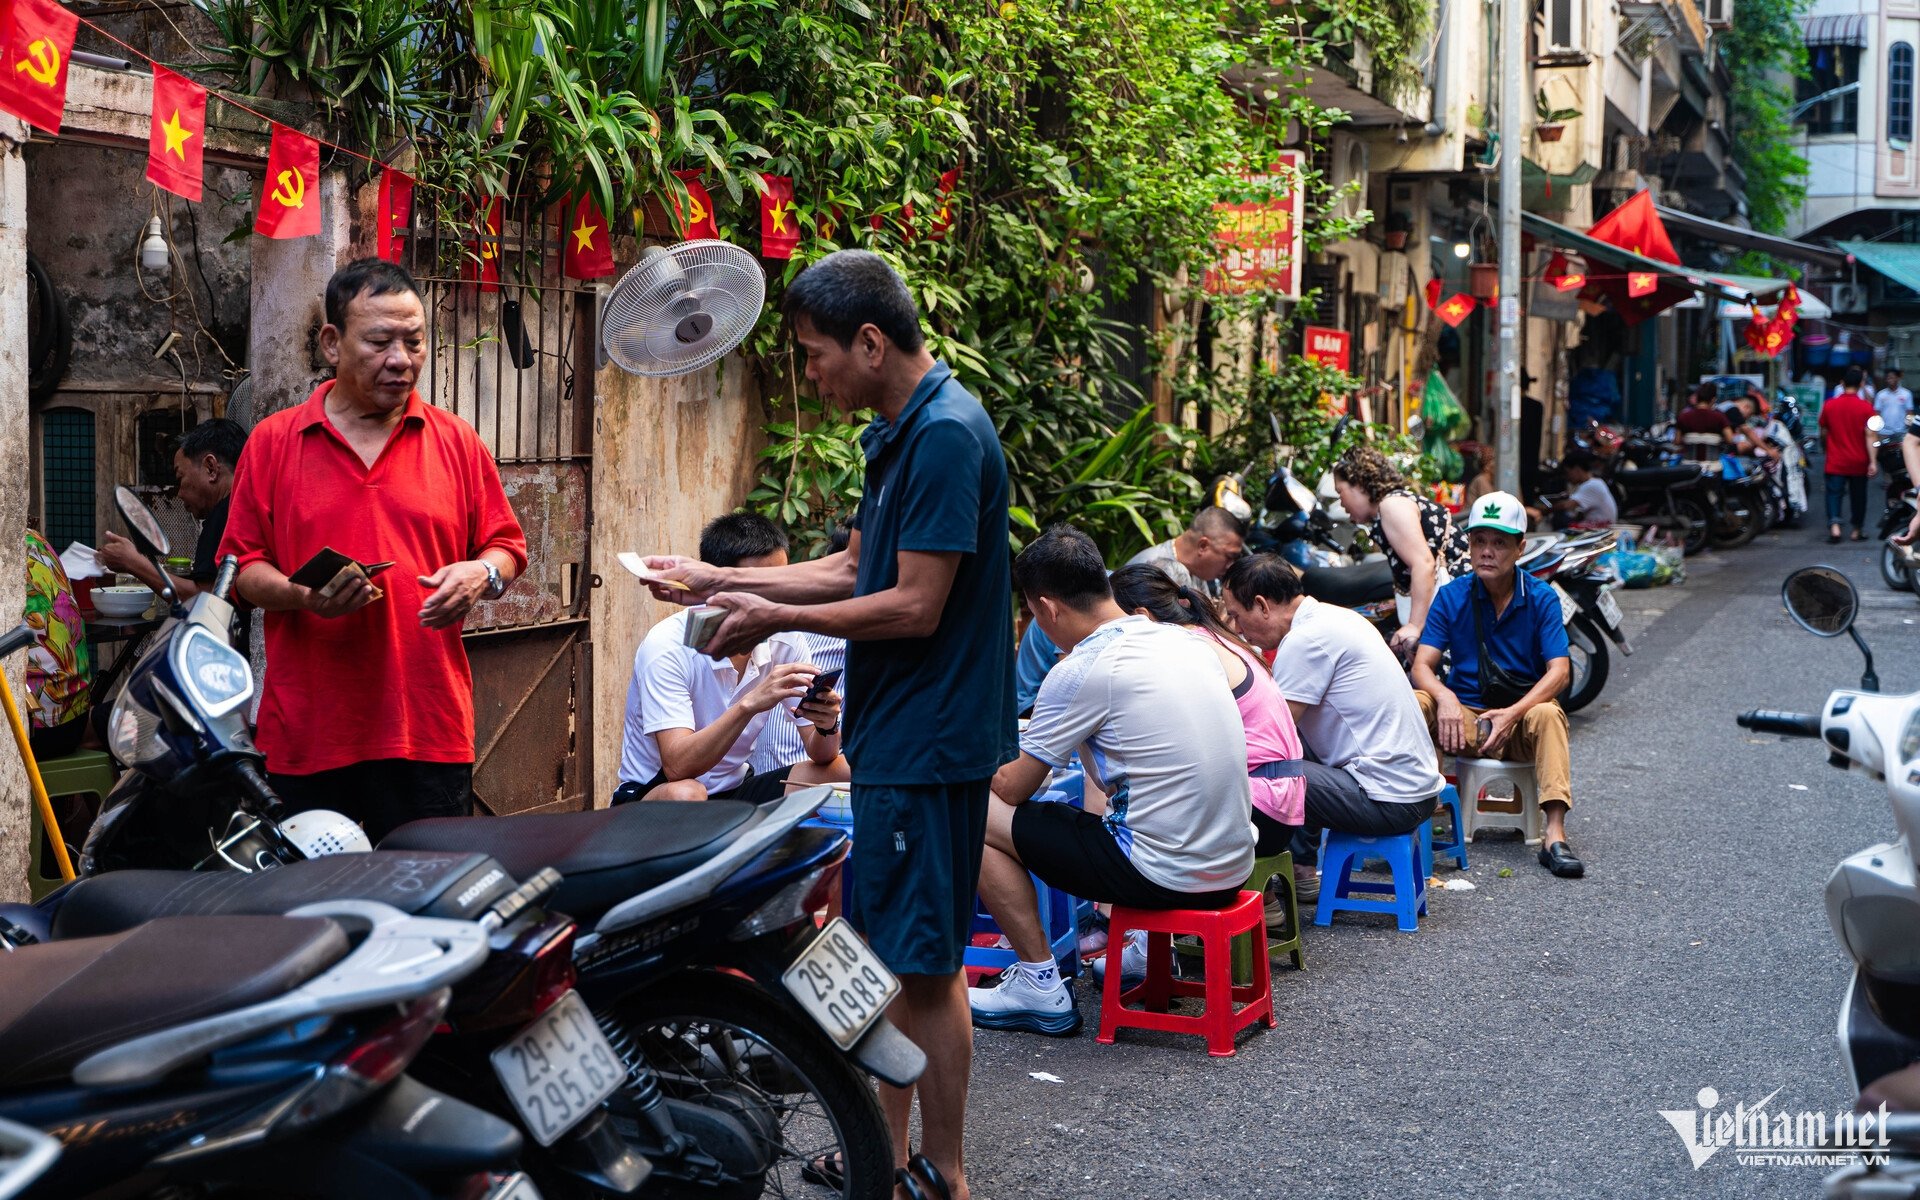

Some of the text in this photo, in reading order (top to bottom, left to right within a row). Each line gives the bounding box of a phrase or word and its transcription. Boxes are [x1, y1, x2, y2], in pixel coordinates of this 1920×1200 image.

[457, 869, 504, 907] HONDA
[798, 932, 859, 1002] 29-X8
[828, 965, 887, 1034] 0989
[527, 1043, 617, 1136] 295.69
